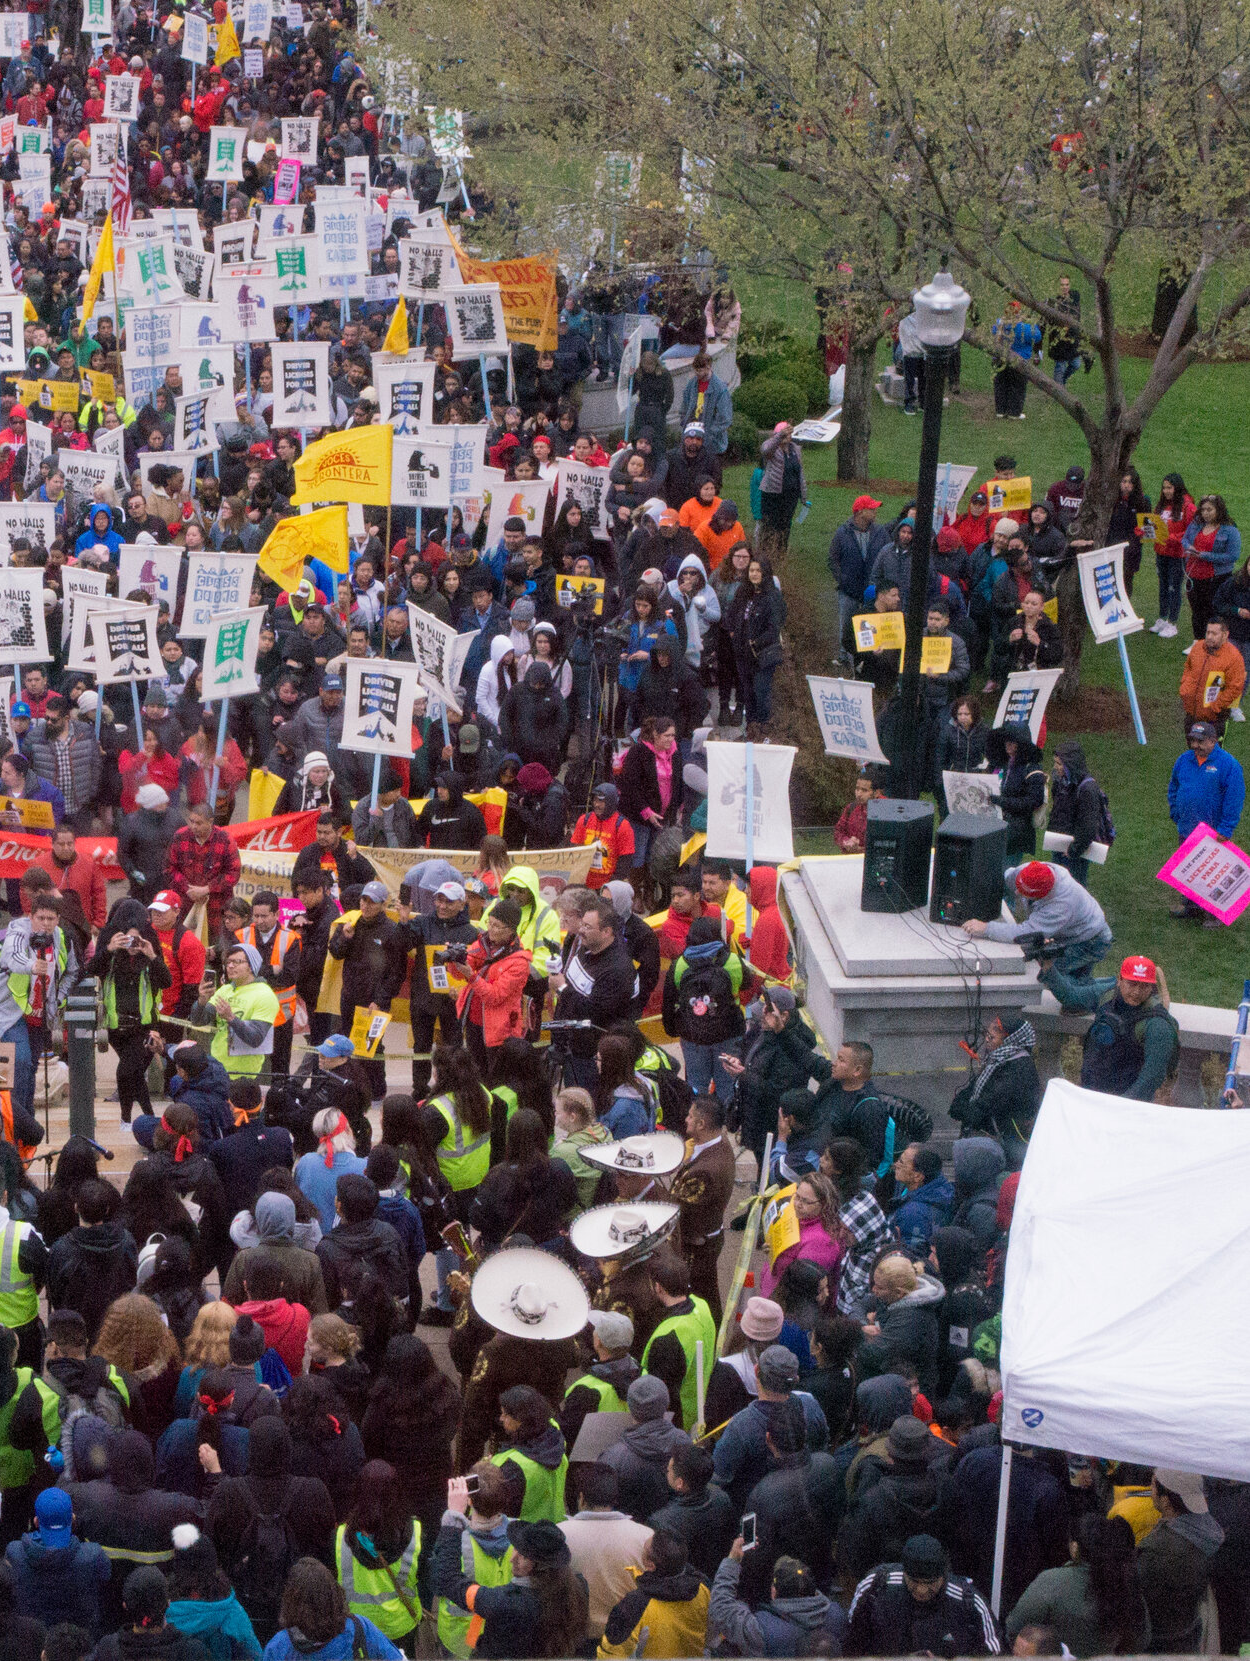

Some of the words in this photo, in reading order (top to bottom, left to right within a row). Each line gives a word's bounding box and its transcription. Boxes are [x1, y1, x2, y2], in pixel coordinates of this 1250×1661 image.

[174, 249, 184, 258] NO
[185, 252, 206, 264] WALLS
[420, 248, 443, 257] WALLS
[455, 296, 466, 305] NO
[467, 294, 492, 305] WALLS
[285, 371, 314, 379] LICENSES
[286, 380, 301, 388] FOR
[392, 384, 418, 394] DRIVER
[392, 402, 406, 410] OR
[408, 402, 420, 410] ALL
[322, 452, 351, 467] VOCES
[67, 466, 79, 474] NO
[81, 466, 106, 480] WALLS
[318, 468, 371, 481] RONTERA
[566, 472, 577, 482] NO
[581, 473, 604, 487] WALLS
[6, 519, 17, 528] NO
[20, 518, 45, 528] WALLS
[69, 582, 79, 592] NO
[79, 583, 99, 594] WALLS
[1098, 589, 1113, 598] FOR
[4, 589, 31, 601] WALLS
[110, 624, 141, 633] DRIVER
[415, 618, 425, 632] NO
[427, 625, 447, 646] WALLS
[112, 643, 128, 651] FOR
[131, 643, 146, 651] ALL
[364, 676, 395, 688] DRIVER
[362, 688, 397, 701] LICENSES
[362, 695, 379, 707] FOR
[382, 702, 395, 712] ALL
[1005, 714, 1017, 722] FOR
[246, 823, 293, 850] ALL
[1187, 848, 1220, 883] LICENCIAS
[1201, 862, 1220, 881] PARA
